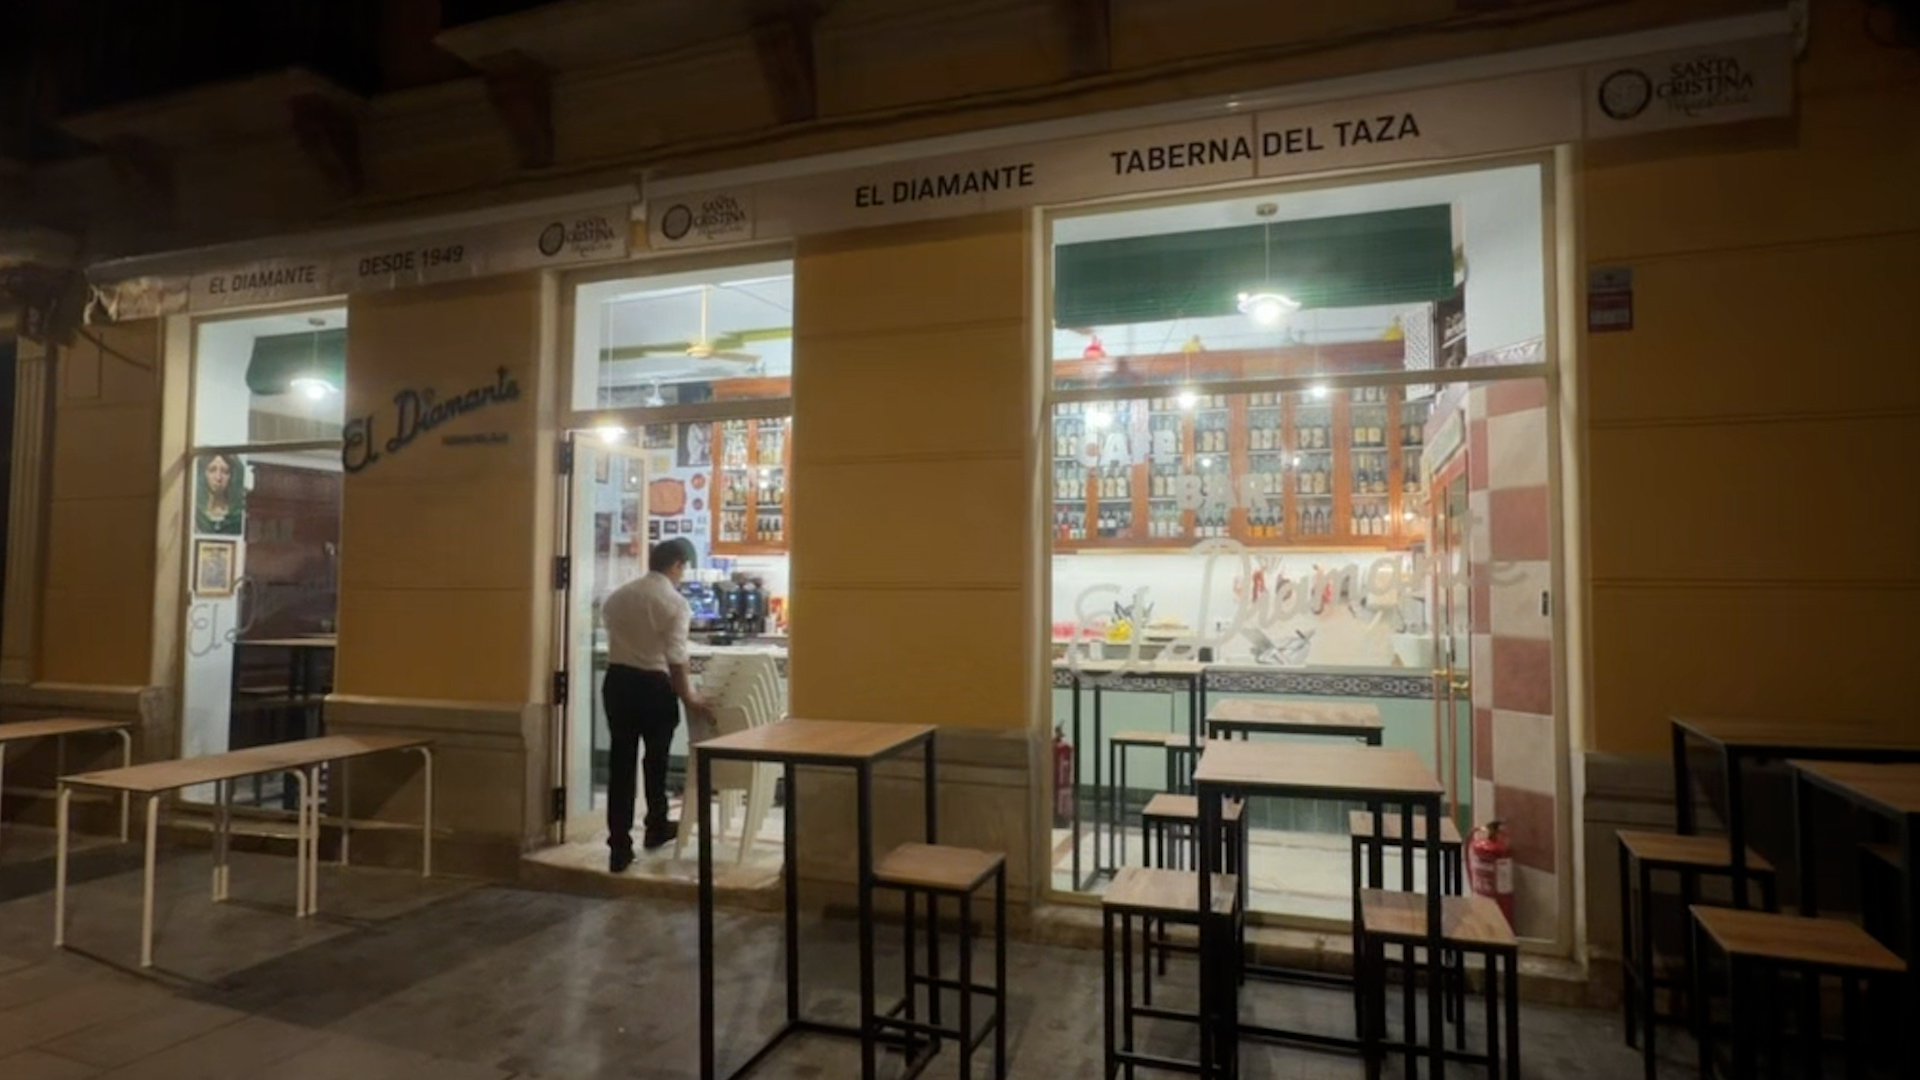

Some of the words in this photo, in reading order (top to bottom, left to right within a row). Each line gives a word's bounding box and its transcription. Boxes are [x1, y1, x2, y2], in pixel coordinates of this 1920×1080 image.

[1656, 71, 1754, 98] CRISTINA
[1670, 56, 1740, 79] SANTA
[1111, 136, 1252, 175] TABERNA
[1264, 127, 1323, 157] DEL
[1333, 112, 1421, 147] TAZA
[855, 186, 884, 208] EL
[893, 163, 1034, 204] DIAMANTE
[209, 276, 227, 295] EL
[232, 265, 317, 292] DIAMANTE
[359, 250, 415, 277] DESDE
[421, 245, 465, 268] 1949
[343, 415, 379, 474] El
[386, 365, 520, 453] Diamante
[1175, 472, 1268, 511] BAR
[1069, 583, 1155, 685] El
